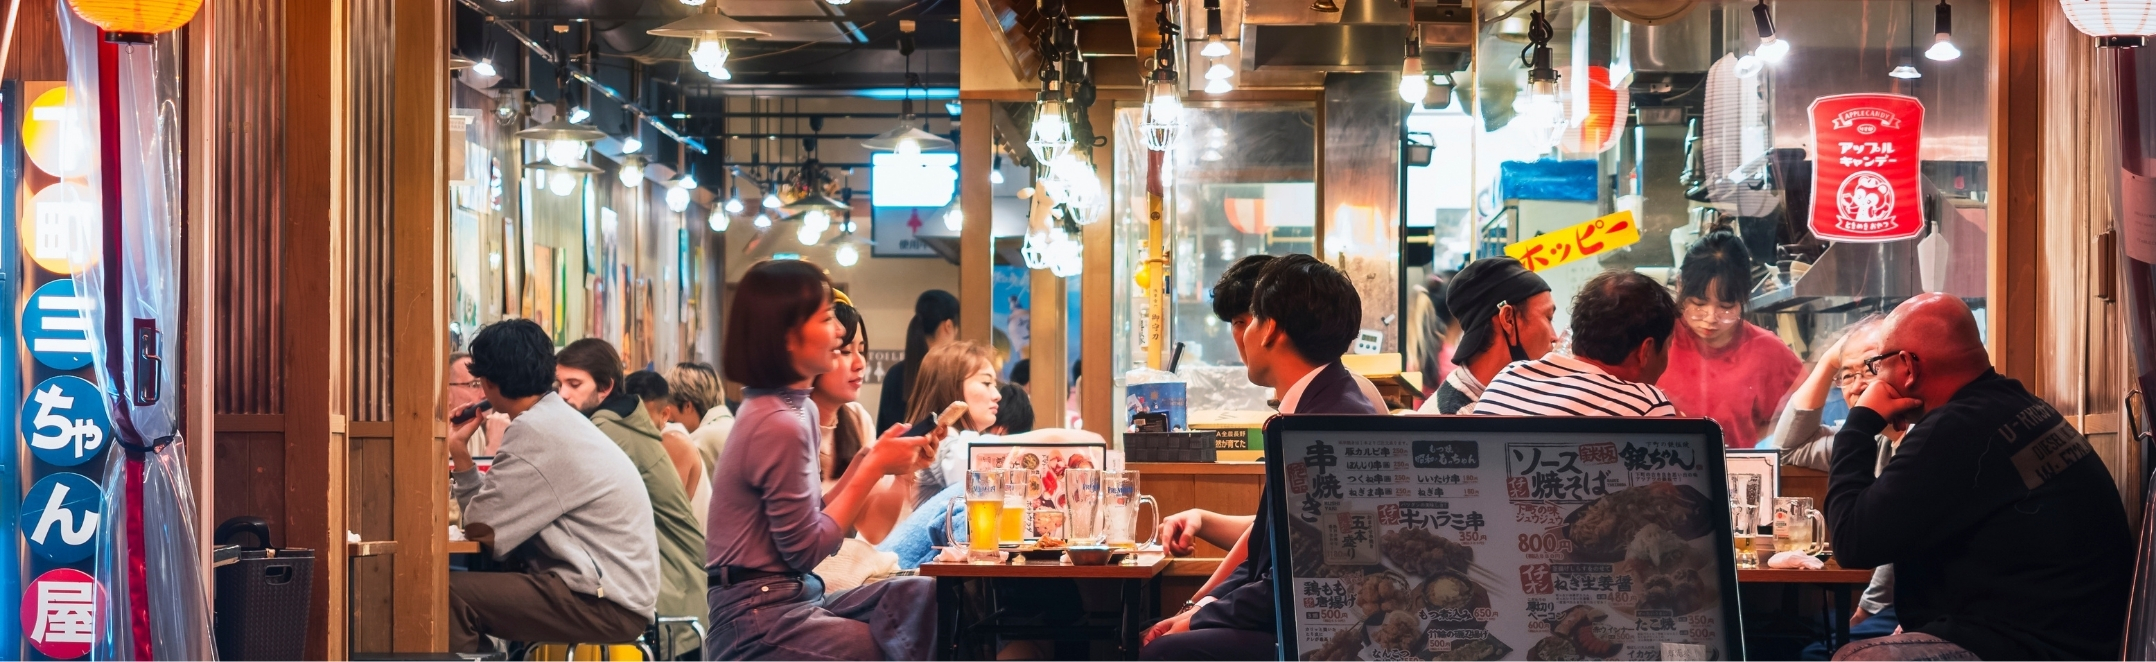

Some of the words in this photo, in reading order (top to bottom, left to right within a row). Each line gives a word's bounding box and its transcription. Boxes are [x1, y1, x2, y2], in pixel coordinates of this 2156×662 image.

[1844, 109, 1865, 120] APPLE
[1865, 109, 1890, 120] CANDY
[1838, 142, 1895, 154] アップル
[1839, 154, 1897, 167] キャンデー
[1519, 219, 1628, 272] ホッピー
[2032, 432, 2066, 461] DIESEL
[1345, 447, 1390, 457] 豚カルビ串
[1618, 442, 1695, 471] 銀ちゃん
[1513, 448, 1583, 475] ソース
[1347, 474, 1383, 484] つくね串
[1417, 474, 1460, 484] しいたけ串
[1531, 470, 1612, 500] 焼そば
[1349, 487, 1384, 497] ねぎま串
[1418, 487, 1444, 497] ねぎ串
[1515, 504, 1560, 516] 下町の味
[1400, 509, 1485, 531] 牛ハラミ串
[1516, 514, 1563, 525] ジュウジュウ
[1459, 531, 1487, 541] 350円
[1518, 534, 1572, 553] 800円
[1303, 580, 1346, 596] 鶏もも
[1314, 593, 1357, 609] 唐揚げ
[1607, 592, 1637, 602] 480円
[1526, 602, 1554, 612] 厚切り
[1321, 609, 1348, 619] 500円
[1418, 608, 1472, 622] もつ煮込み
[1473, 608, 1498, 618] 650円
[1528, 612, 1566, 621] ベーコン
[1528, 621, 1550, 629] 600円
[1635, 617, 1676, 632] たこ焼
[1688, 615, 1715, 625] 350円
[1690, 628, 1716, 638] 500円
[1430, 640, 1450, 648] 500円
[1372, 648, 1410, 658] なんこつ
